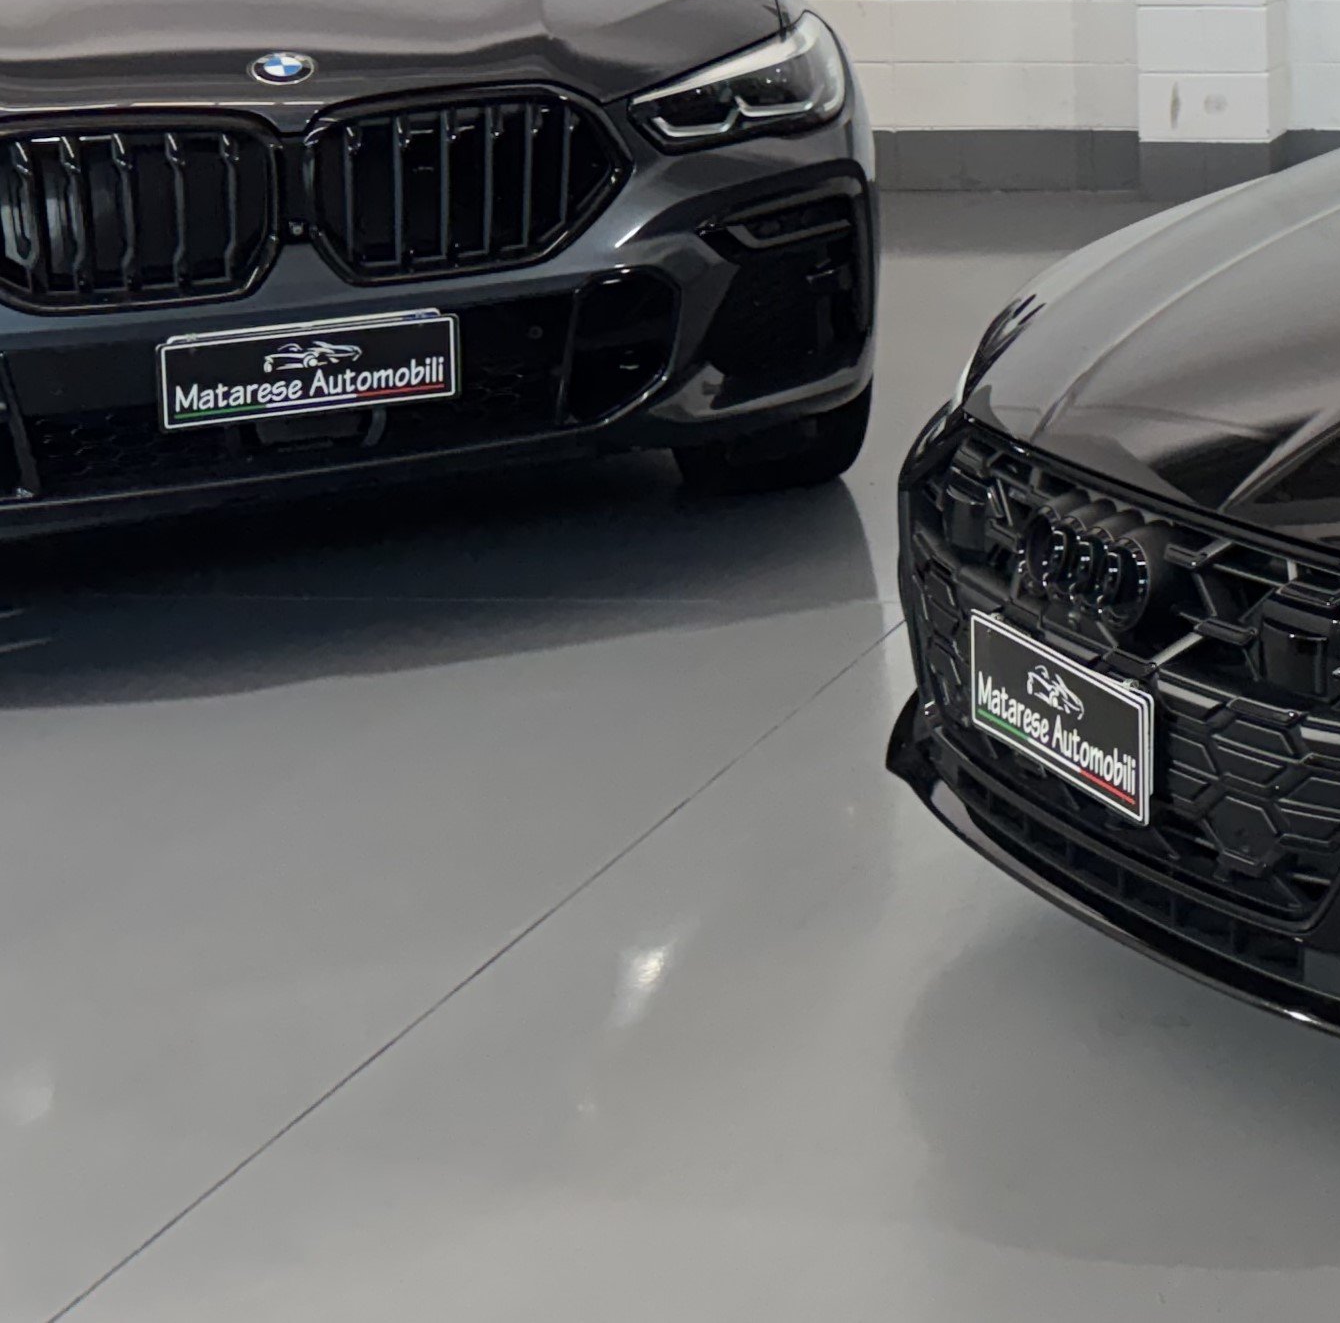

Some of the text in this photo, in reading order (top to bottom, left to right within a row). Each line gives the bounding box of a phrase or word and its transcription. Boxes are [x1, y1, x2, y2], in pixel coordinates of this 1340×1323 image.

[175, 356, 445, 413] Matarese Automobili
[977, 671, 1137, 796] Matarese Automobili
